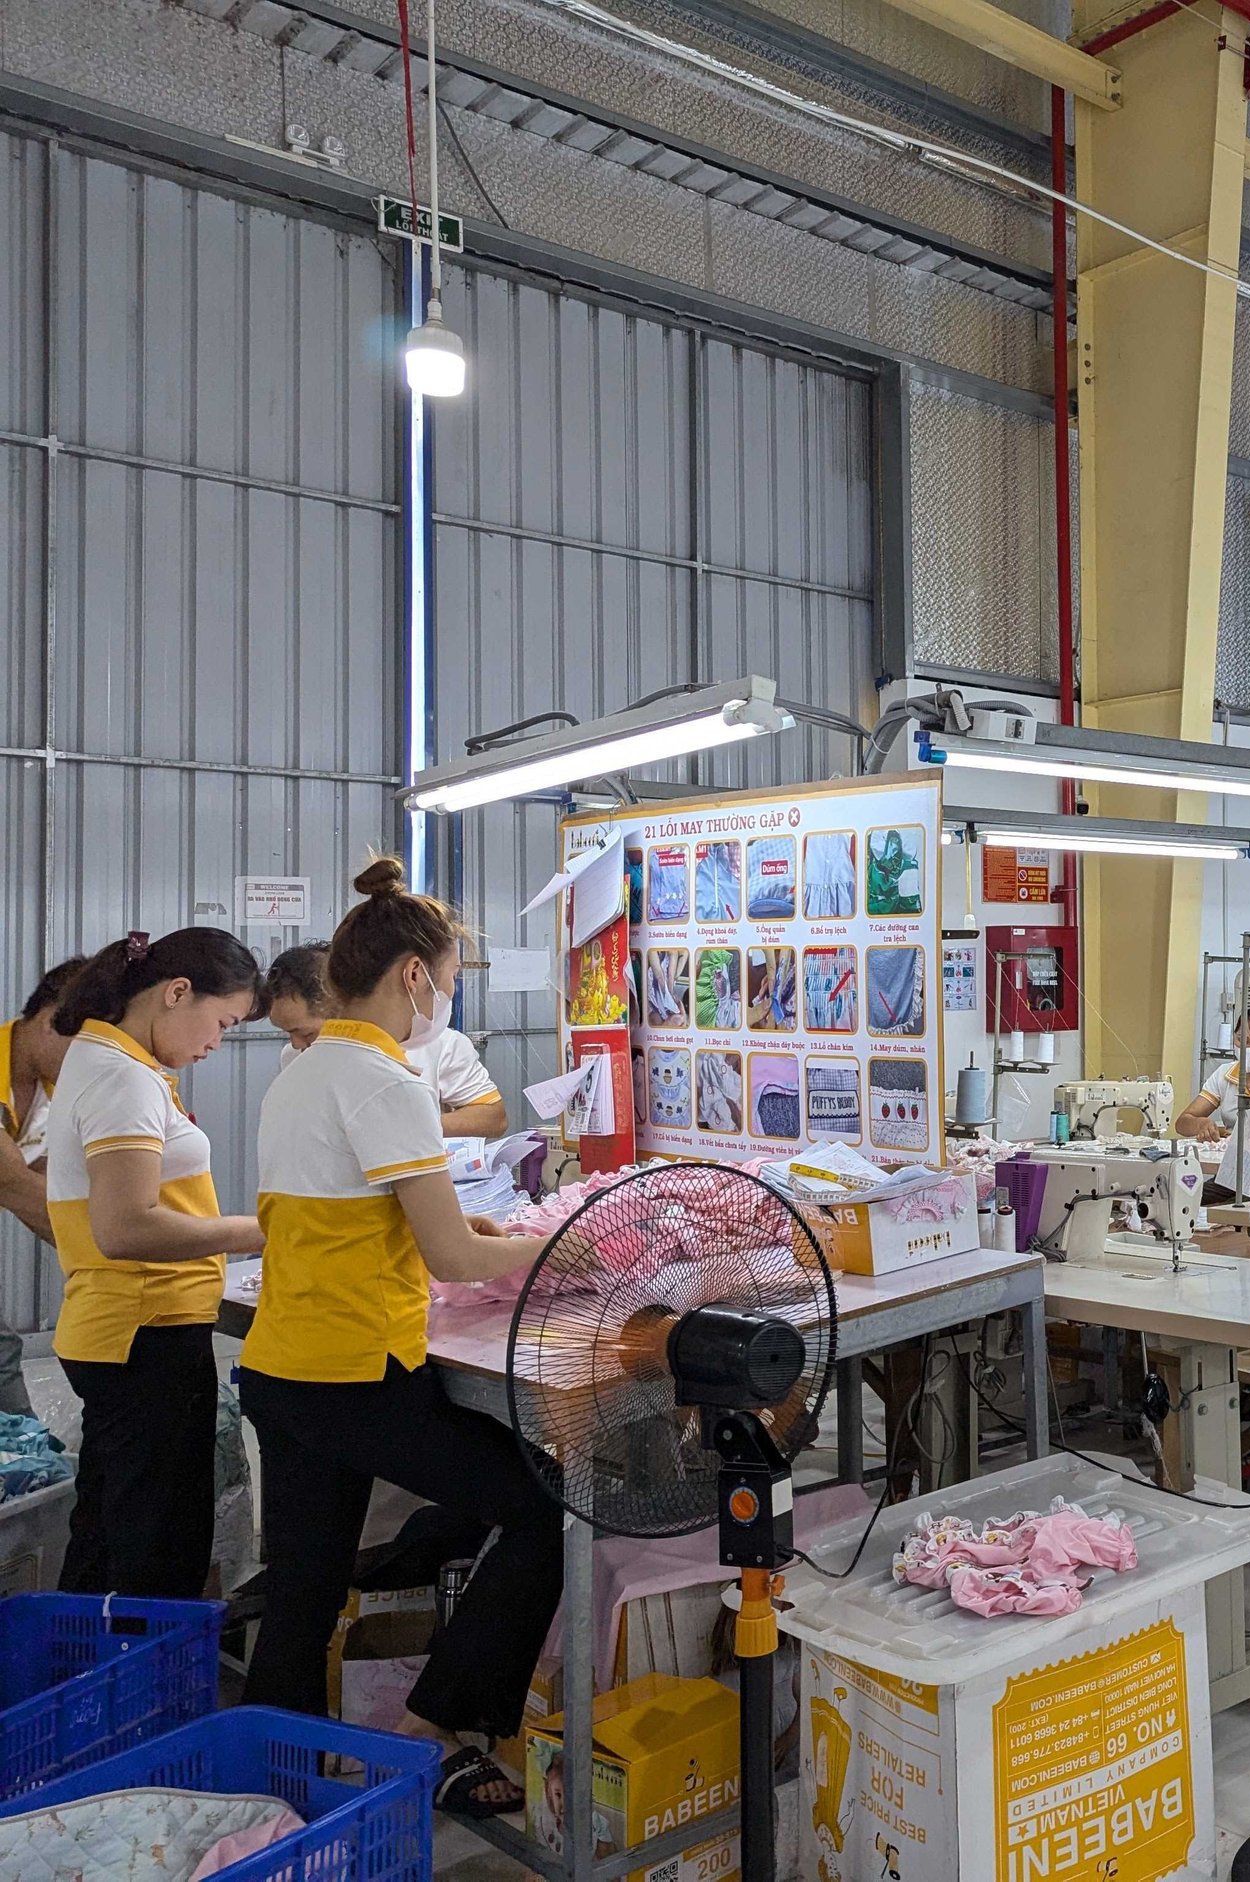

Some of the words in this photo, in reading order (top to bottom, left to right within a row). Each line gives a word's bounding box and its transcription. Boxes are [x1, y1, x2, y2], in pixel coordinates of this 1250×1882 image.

[401, 207, 443, 225] EXI
[645, 825, 656, 839] 21
[681, 820, 704, 836] MAY
[1139, 1686, 1156, 1702] BIEN
[1157, 1676, 1177, 1693] LONG
[1105, 1695, 1138, 1719] DISTRICT
[1137, 1700, 1159, 1718] HUNG
[1161, 1692, 1178, 1708] VIET
[1034, 1722, 1057, 1740] 3668
[1058, 1717, 1070, 1731] 24
[1105, 1710, 1136, 1734] STREET
[1133, 1714, 1163, 1743] NO.
[1106, 1732, 1127, 1759] 66
[858, 1731, 926, 1788] RETAILERS
[1106, 1736, 1180, 1783] COMPANY
[1011, 1755, 1087, 1792] BABEENI.COM
[871, 1767, 904, 1811] FOR
[1012, 1778, 1093, 1819] LIMITED
[860, 1790, 890, 1824] PRICE
[1040, 1784, 1126, 1833] VIETNAM
[892, 1817, 926, 1845] BEST
[1007, 1777, 1182, 1882] BABEENI
[697, 1847, 731, 1880] 200
